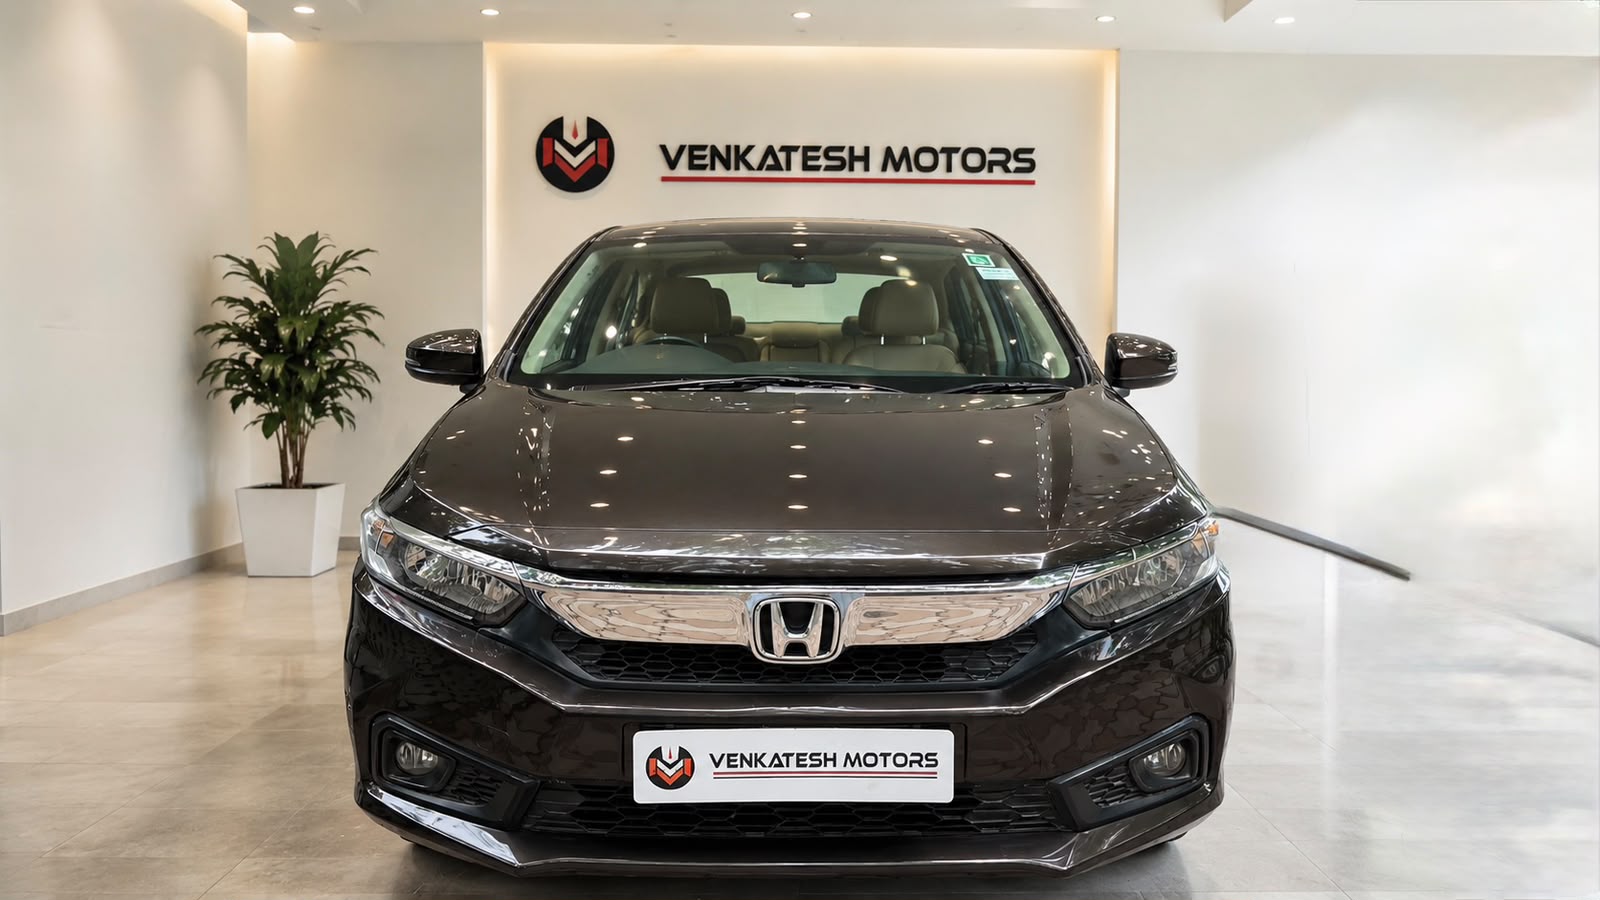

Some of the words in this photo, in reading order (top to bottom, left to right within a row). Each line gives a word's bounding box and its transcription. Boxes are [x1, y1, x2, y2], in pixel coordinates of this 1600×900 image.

[659, 144, 870, 172] VENKATESH
[881, 146, 1036, 174] MOTORS
[709, 752, 837, 768] VENKATESH
[843, 752, 939, 768] MOTORS
